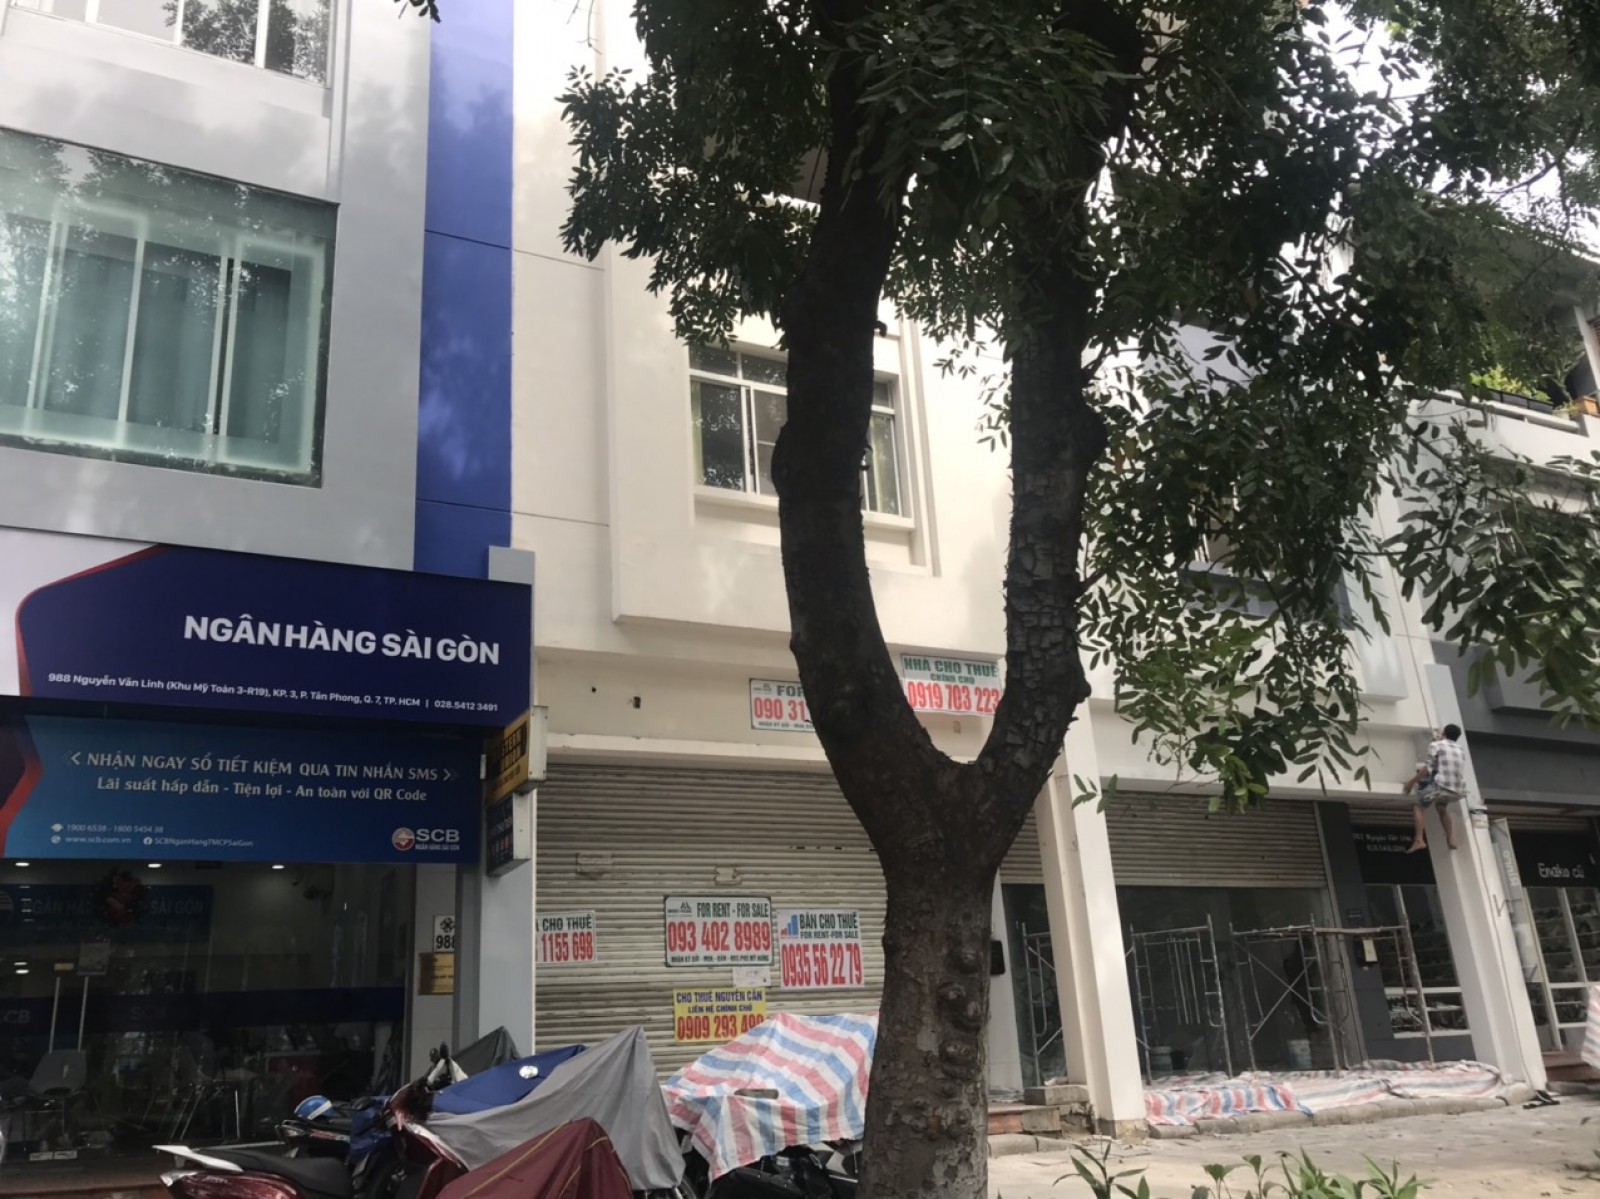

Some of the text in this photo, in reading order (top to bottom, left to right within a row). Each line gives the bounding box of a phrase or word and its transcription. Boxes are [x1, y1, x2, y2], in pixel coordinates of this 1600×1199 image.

[184, 613, 500, 665] NGÂN HÀNG SÀI GÒN
[934, 660, 962, 674] CHO
[964, 662, 998, 678] THUÊ
[48, 672, 72, 682] 988
[73, 675, 116, 688] Nguyễn
[118, 677, 140, 687] Văn
[141, 679, 165, 690] Linh
[167, 681, 192, 692] (Khu
[193, 682, 208, 694] Mỹ
[272, 689, 288, 698] KP.
[300, 691, 309, 700] P.
[310, 690, 328, 701] Tân
[329, 693, 362, 705] Phong,
[384, 697, 398, 706] TP.
[399, 698, 421, 707] HCM
[907, 681, 1001, 714] 0919 703 223
[754, 696, 783, 721] 090
[87, 750, 438, 781] NHẬN NGAY SỔ TIẾT KIỆM QUA TIN NHẮN SMS
[97, 776, 428, 801] Lãi suất hấp dẫn Tiện lợi An toàn với QR Code
[67, 824, 87, 833] 1900
[415, 827, 461, 843] SCB
[543, 917, 563, 931] CHO
[566, 913, 592, 930] THUÊ
[697, 902, 769, 918] FOR RENT FOR SALE
[799, 911, 858, 930] BÁN CHO THUÊ
[541, 931, 593, 962] 1155 698
[668, 921, 771, 952] 093 402 8989
[782, 942, 863, 987] 0935 56 22 79
[676, 992, 692, 1004] CHO
[694, 990, 712, 1003] THUÊ
[715, 990, 745, 1002] NGUYÊN
[0, 1008, 31, 1023] CB
[677, 1015, 710, 1040] 0909
[713, 1014, 738, 1038] 293
